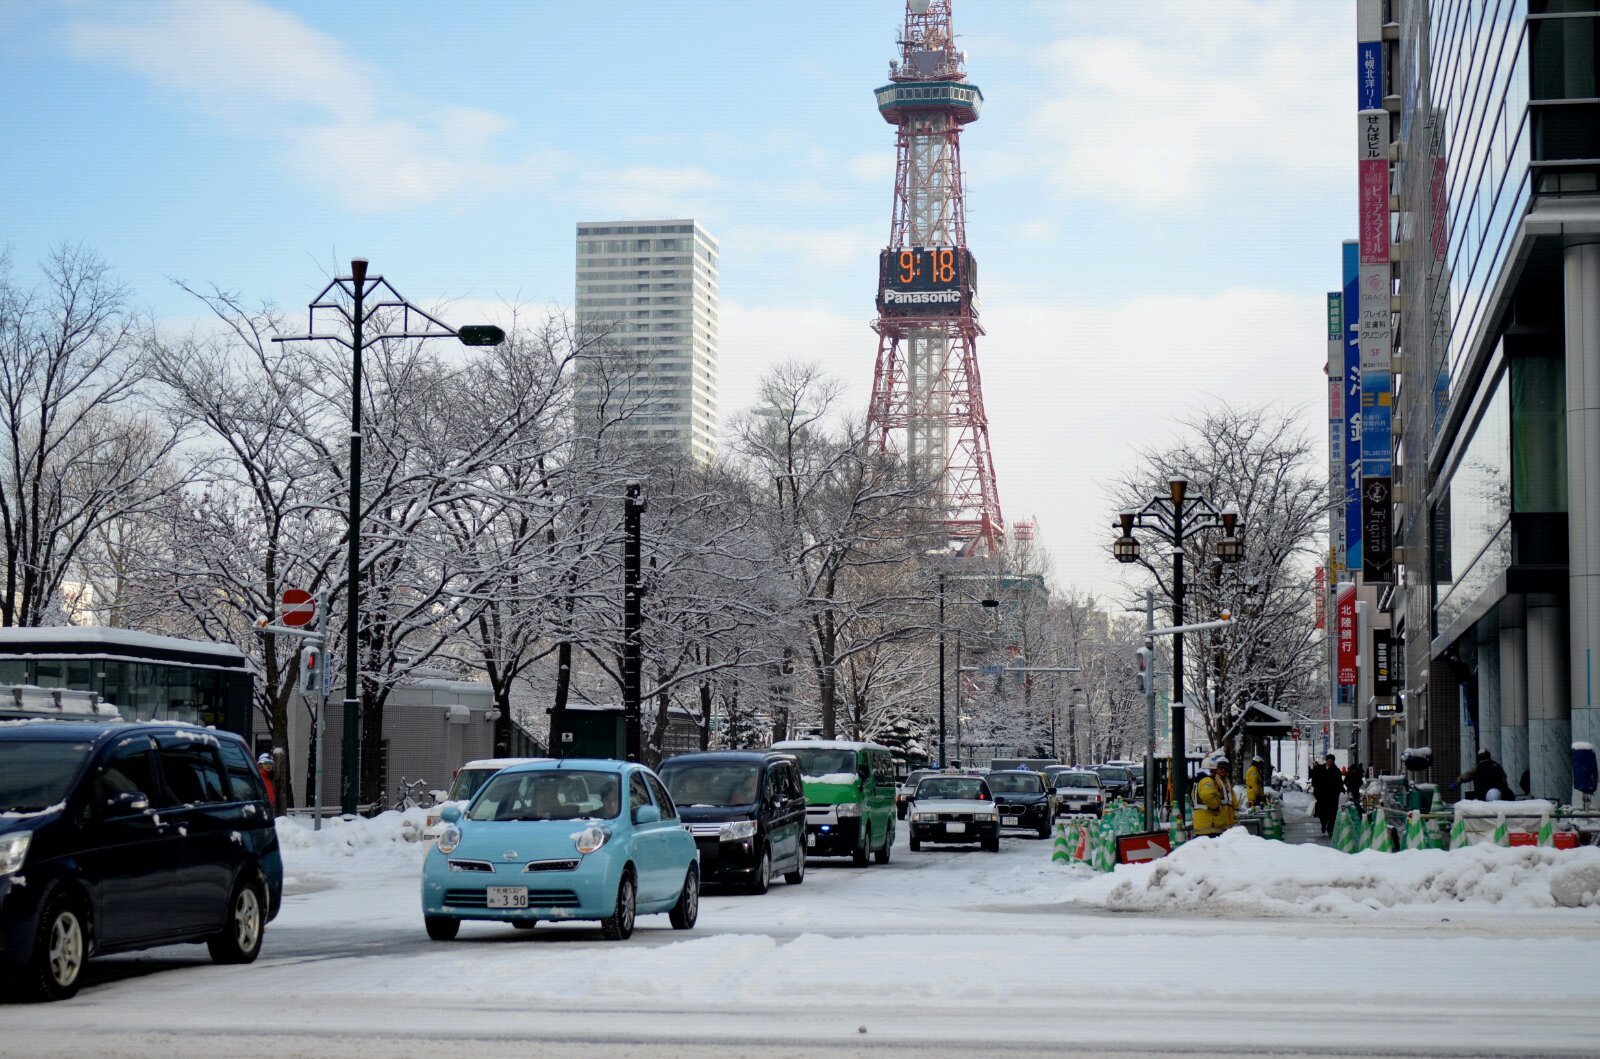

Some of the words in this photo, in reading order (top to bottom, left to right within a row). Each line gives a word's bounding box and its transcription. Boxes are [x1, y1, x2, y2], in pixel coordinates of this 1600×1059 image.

[1367, 116, 1380, 158] せんばビル
[1372, 185, 1384, 254] ピュアスマイル
[900, 250, 954, 283] 9:18
[884, 288, 961, 304] Panasonic
[1363, 310, 1388, 318] グレイス
[1361, 331, 1389, 339] クリニック
[1364, 321, 1386, 329] 皮膚科
[1365, 507, 1386, 552] Figaro
[1341, 605, 1352, 652] 北陸銀行
[1377, 643, 1389, 682] DOUTOR
